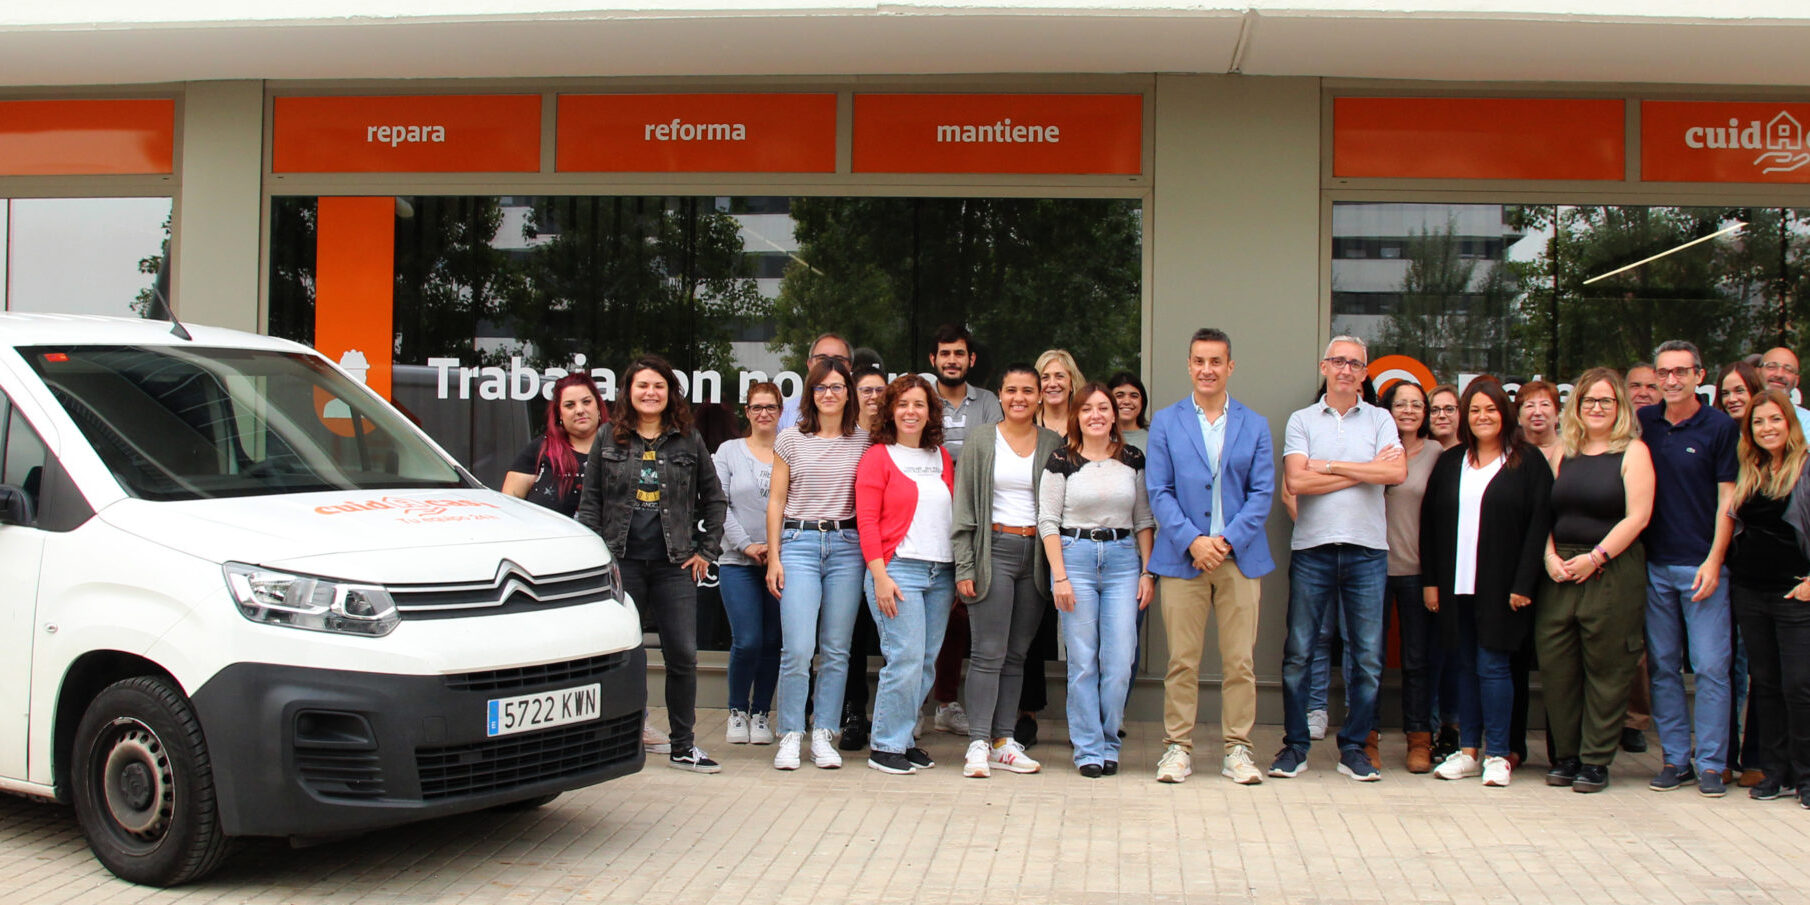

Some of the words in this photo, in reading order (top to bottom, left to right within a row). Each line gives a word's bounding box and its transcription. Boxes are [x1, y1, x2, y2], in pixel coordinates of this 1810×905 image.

[366, 125, 446, 147] repara
[644, 118, 746, 142] reforma
[936, 118, 1060, 143] mantiene
[428, 353, 616, 402] Trabaa
[505, 696, 555, 729] 5722
[562, 688, 596, 719] KWN
